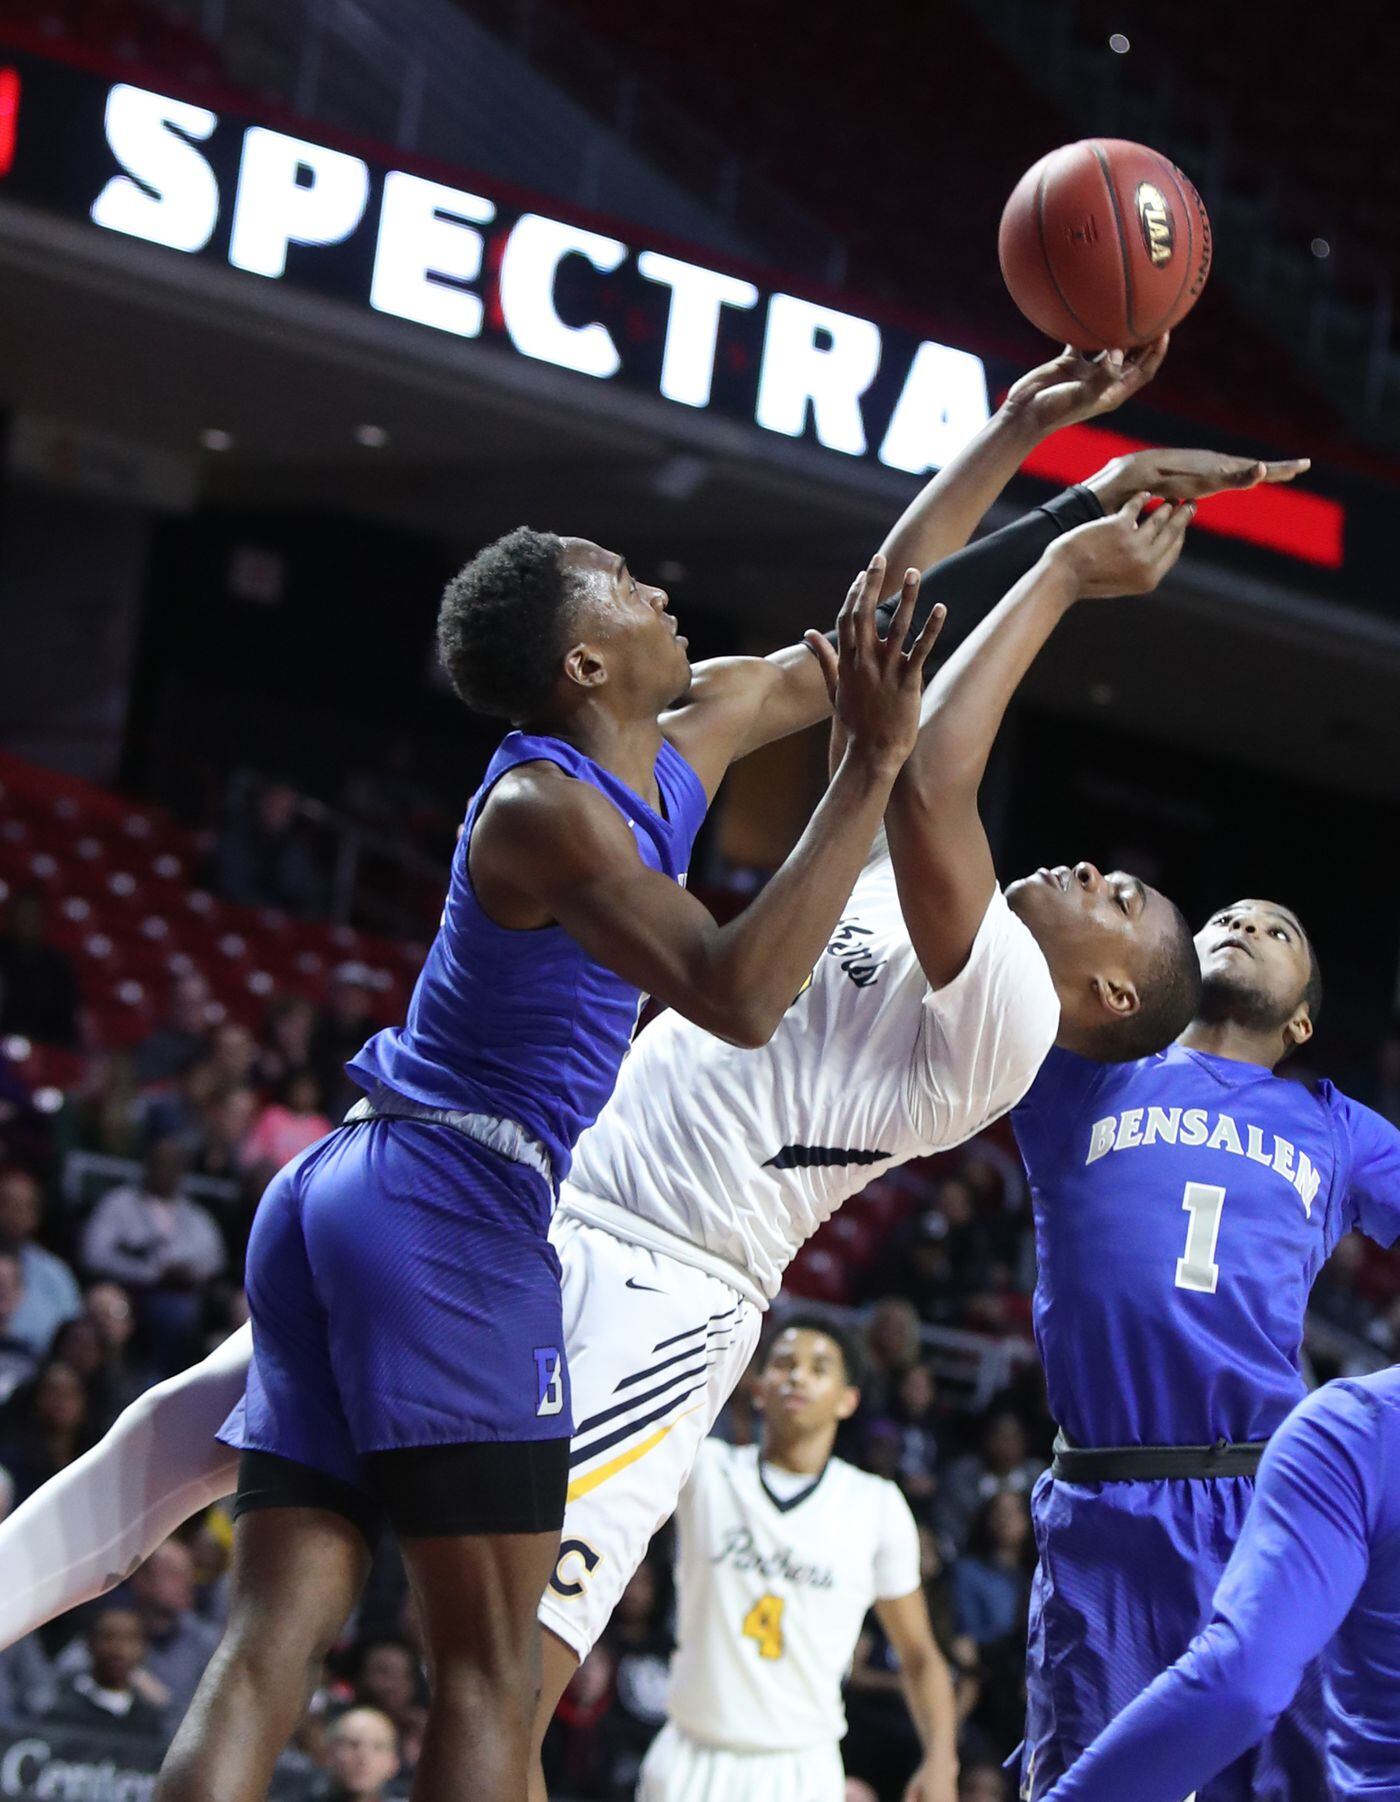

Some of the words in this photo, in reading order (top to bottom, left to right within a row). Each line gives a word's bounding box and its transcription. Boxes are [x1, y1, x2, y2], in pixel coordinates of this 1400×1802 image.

[90, 82, 994, 476] SPECTRA
[1085, 1106, 1321, 1220] BENSALEM
[1174, 1180, 1227, 1294] 1
[533, 1346, 564, 1418] B
[549, 1535, 604, 1601] C
[710, 1526, 834, 1589] Panthers
[741, 1591, 786, 1664] 4
